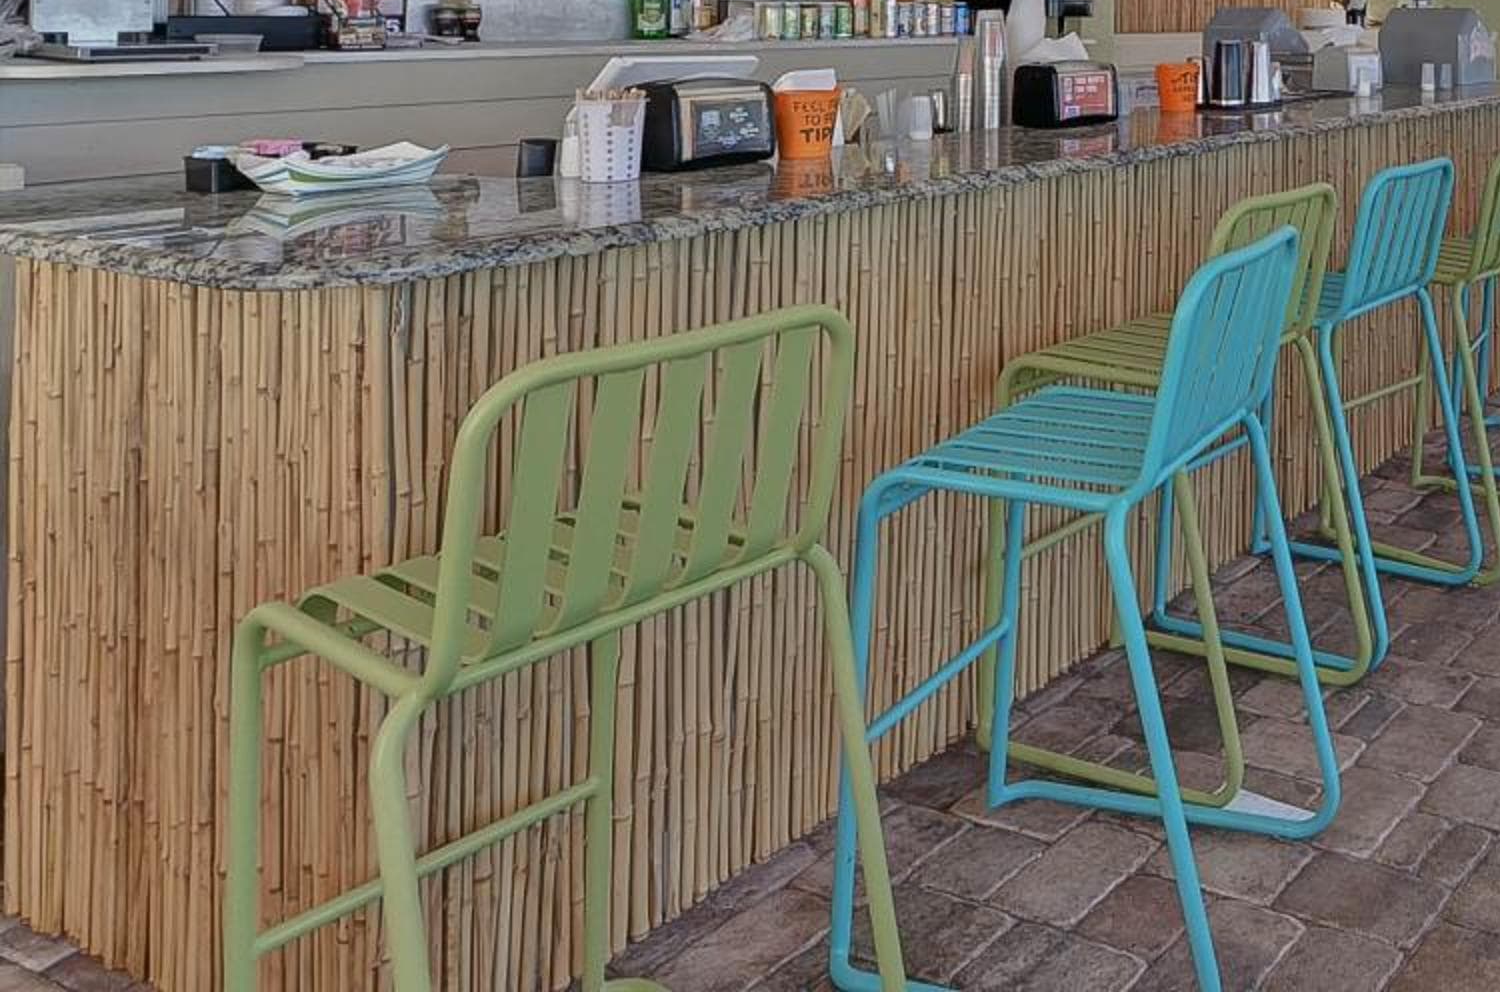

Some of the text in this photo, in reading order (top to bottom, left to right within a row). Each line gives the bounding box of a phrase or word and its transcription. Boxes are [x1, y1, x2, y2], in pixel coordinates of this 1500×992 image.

[793, 100, 826, 113] FEEL
[801, 113, 821, 126] TO
[799, 127, 833, 144] TIP
